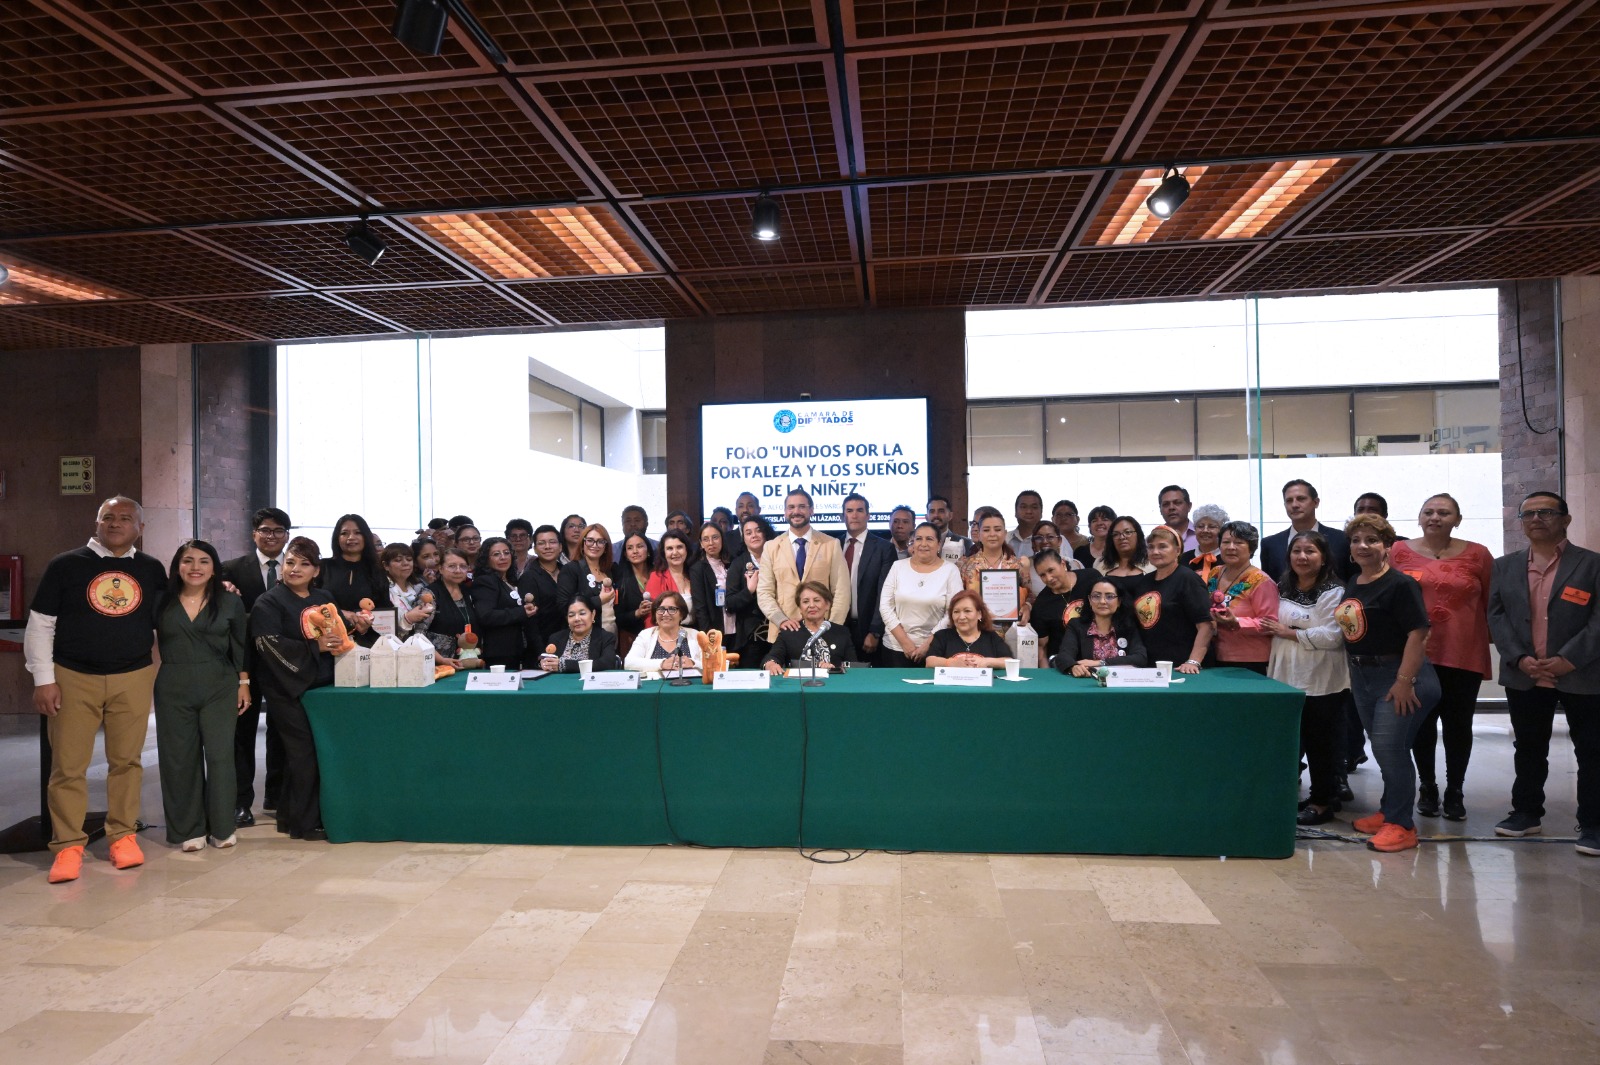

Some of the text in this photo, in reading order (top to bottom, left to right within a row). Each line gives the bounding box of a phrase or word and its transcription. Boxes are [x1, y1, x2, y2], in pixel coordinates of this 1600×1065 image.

[798, 416, 853, 424] DIPTADOS
[726, 443, 903, 460] FORO "UNIDOS POR LA
[711, 458, 919, 479] FORTALEZA Y LOS SUEÑOS
[763, 484, 782, 497] DE
[811, 479, 866, 496] NIÑEZ"
